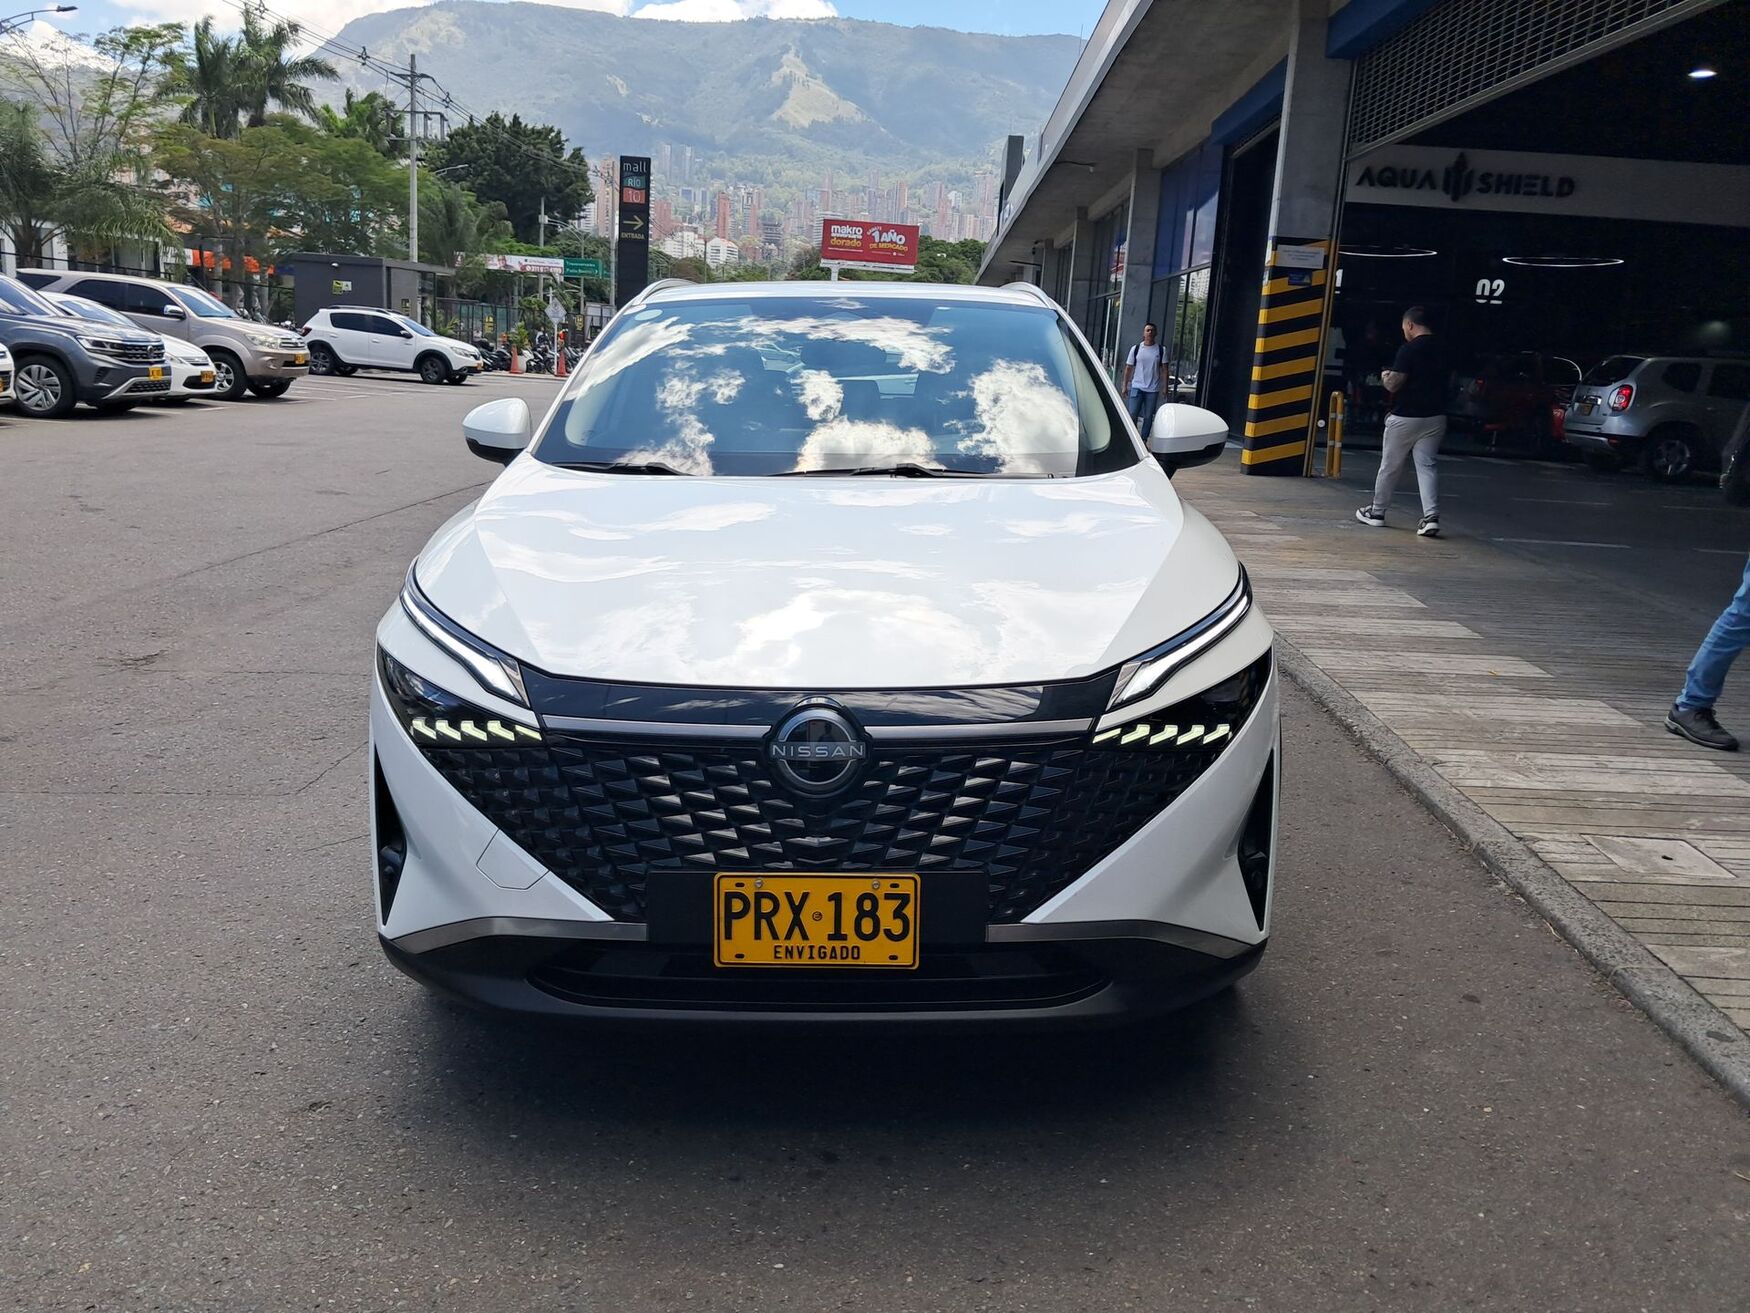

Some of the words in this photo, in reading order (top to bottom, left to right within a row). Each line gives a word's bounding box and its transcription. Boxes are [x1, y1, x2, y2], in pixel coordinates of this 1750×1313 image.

[623, 161, 647, 172] mall
[1355, 166, 1437, 190] AQUA
[1475, 171, 1576, 198] SHIELD
[628, 190, 641, 203] 10
[621, 232, 646, 240] ENTRADA
[831, 225, 863, 235] makro
[830, 238, 862, 247] dorado
[872, 230, 880, 243] 1
[881, 229, 906, 245] AÑO
[1475, 278, 1505, 304] 02
[772, 745, 863, 757] NISSAN
[723, 891, 810, 941] PRX
[827, 892, 911, 942] 183
[773, 945, 861, 960] ENVIGADO
